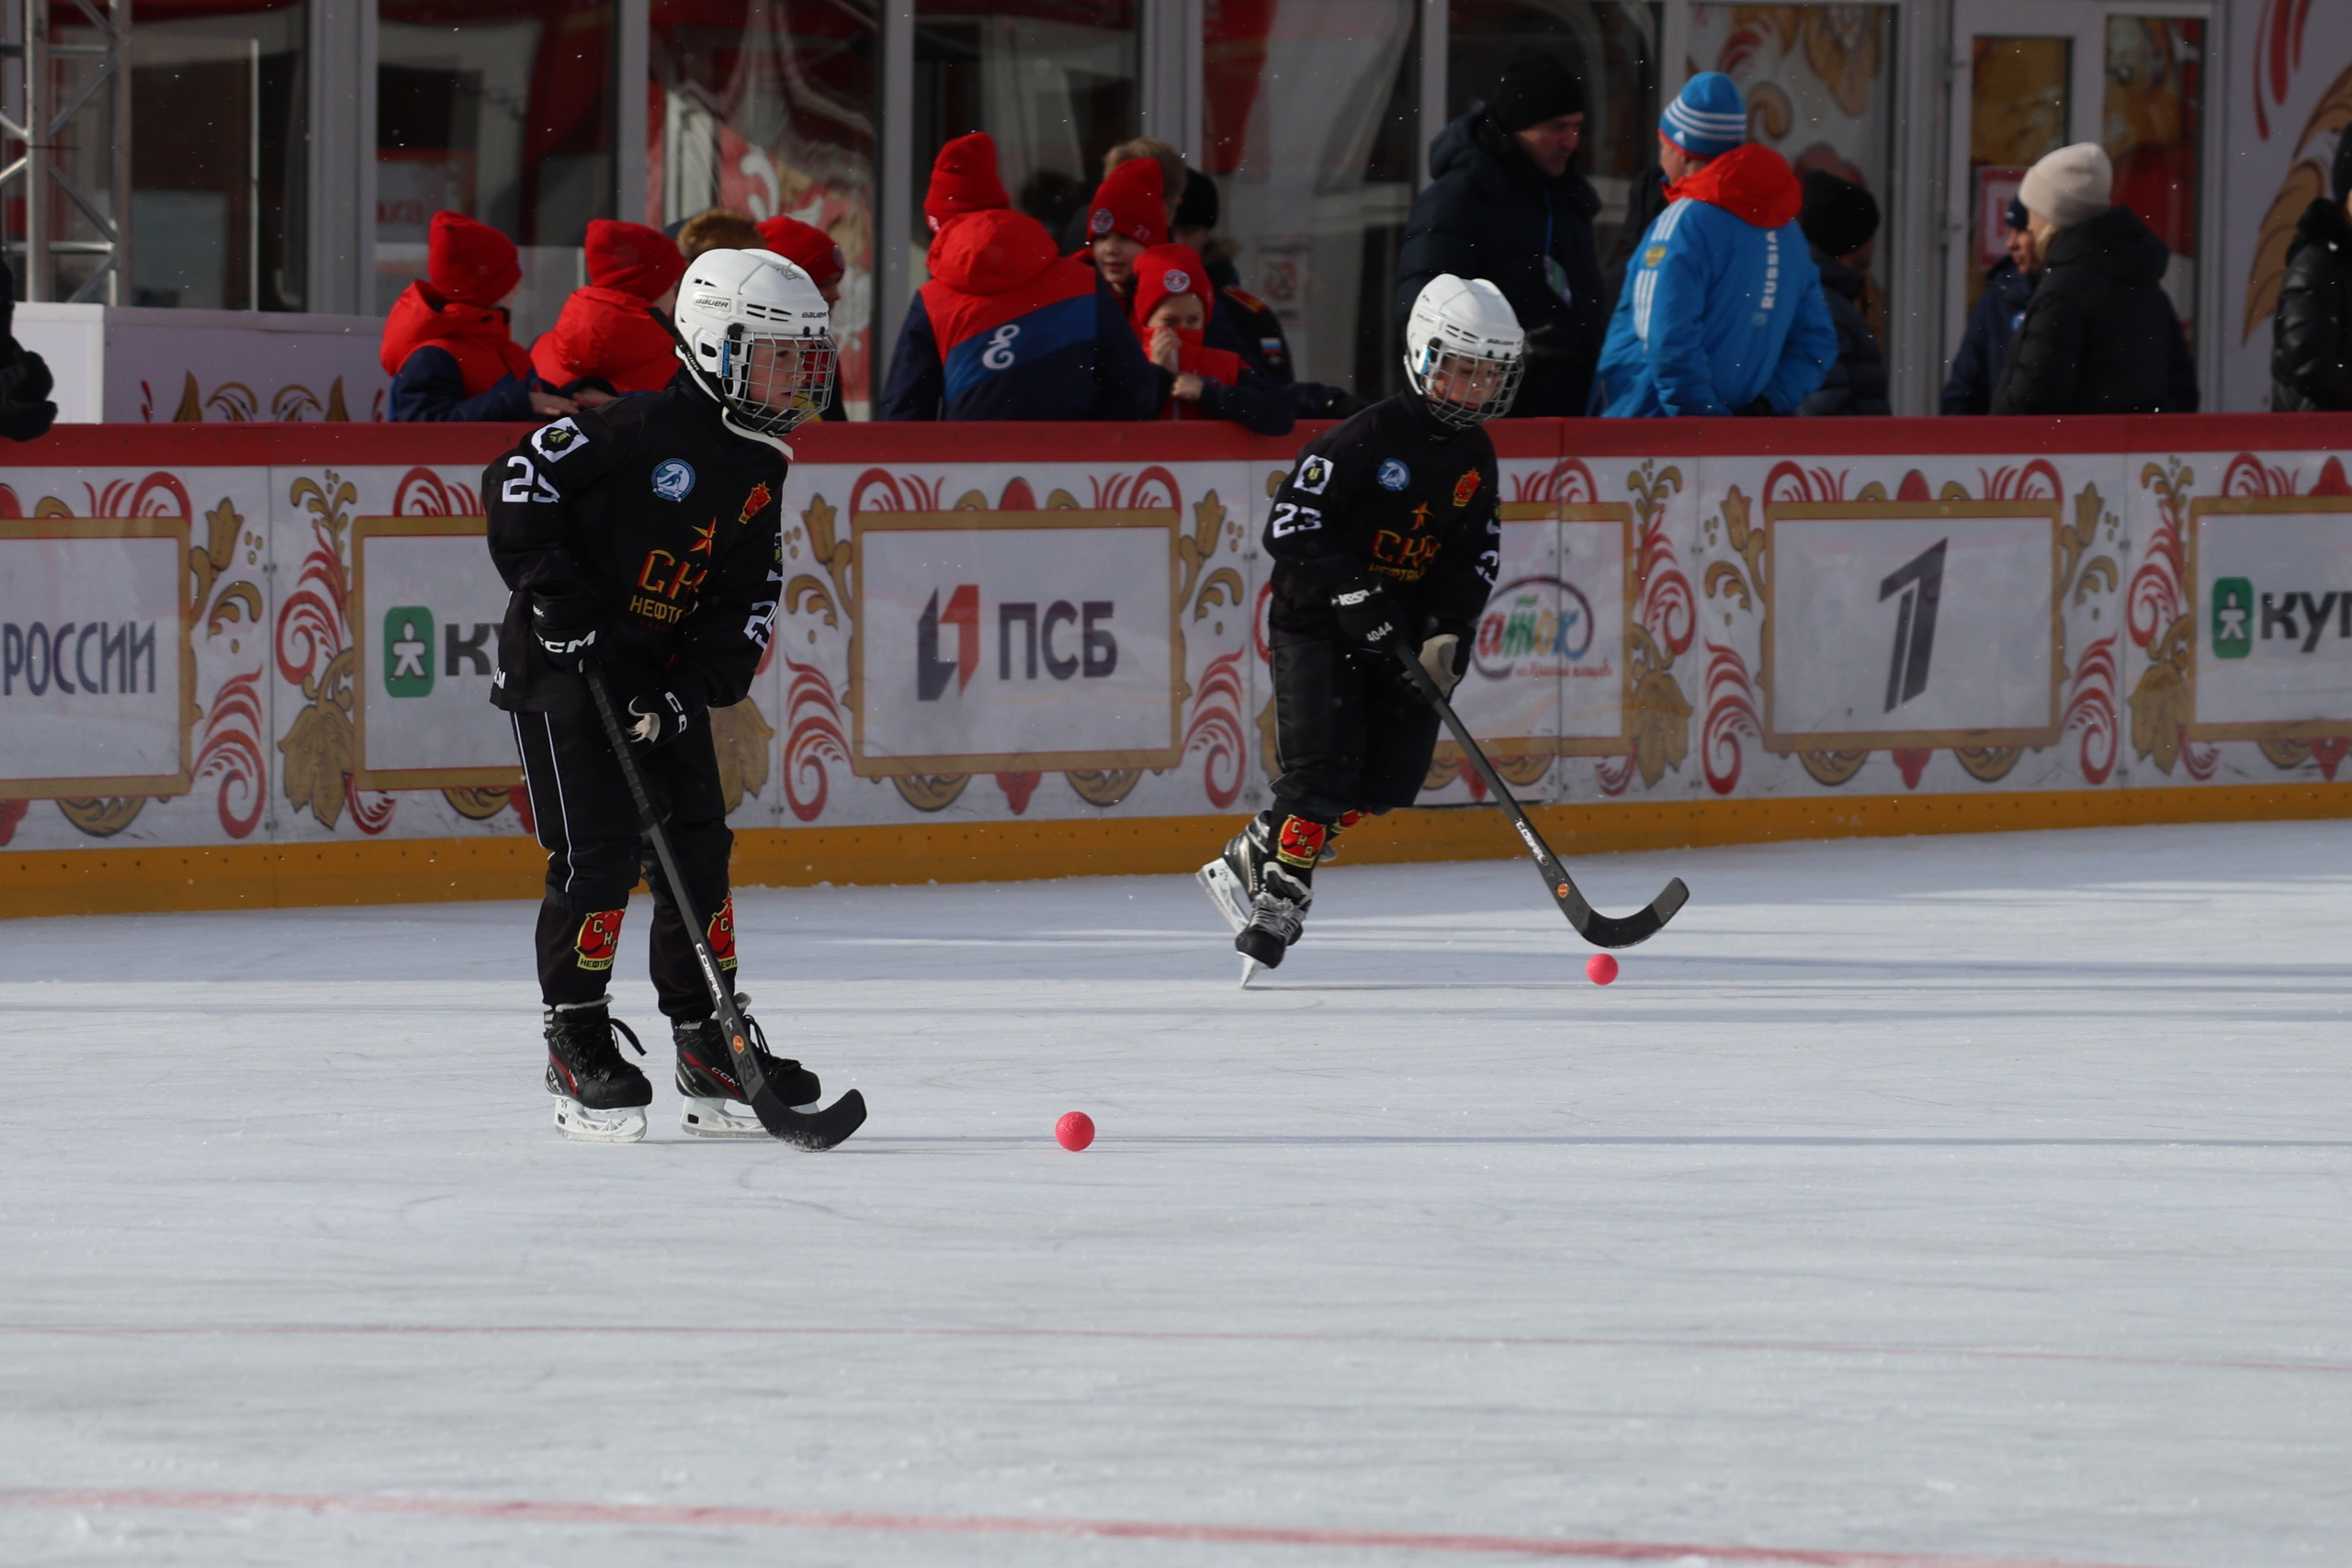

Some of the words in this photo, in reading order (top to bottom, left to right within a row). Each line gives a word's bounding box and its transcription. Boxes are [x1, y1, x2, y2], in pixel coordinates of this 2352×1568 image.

[1761, 230, 1779, 309] RUSSIA
[1272, 502, 1322, 538] 23
[3, 621, 155, 696] РОССИИ
[998, 600, 1118, 681] ПСБ
